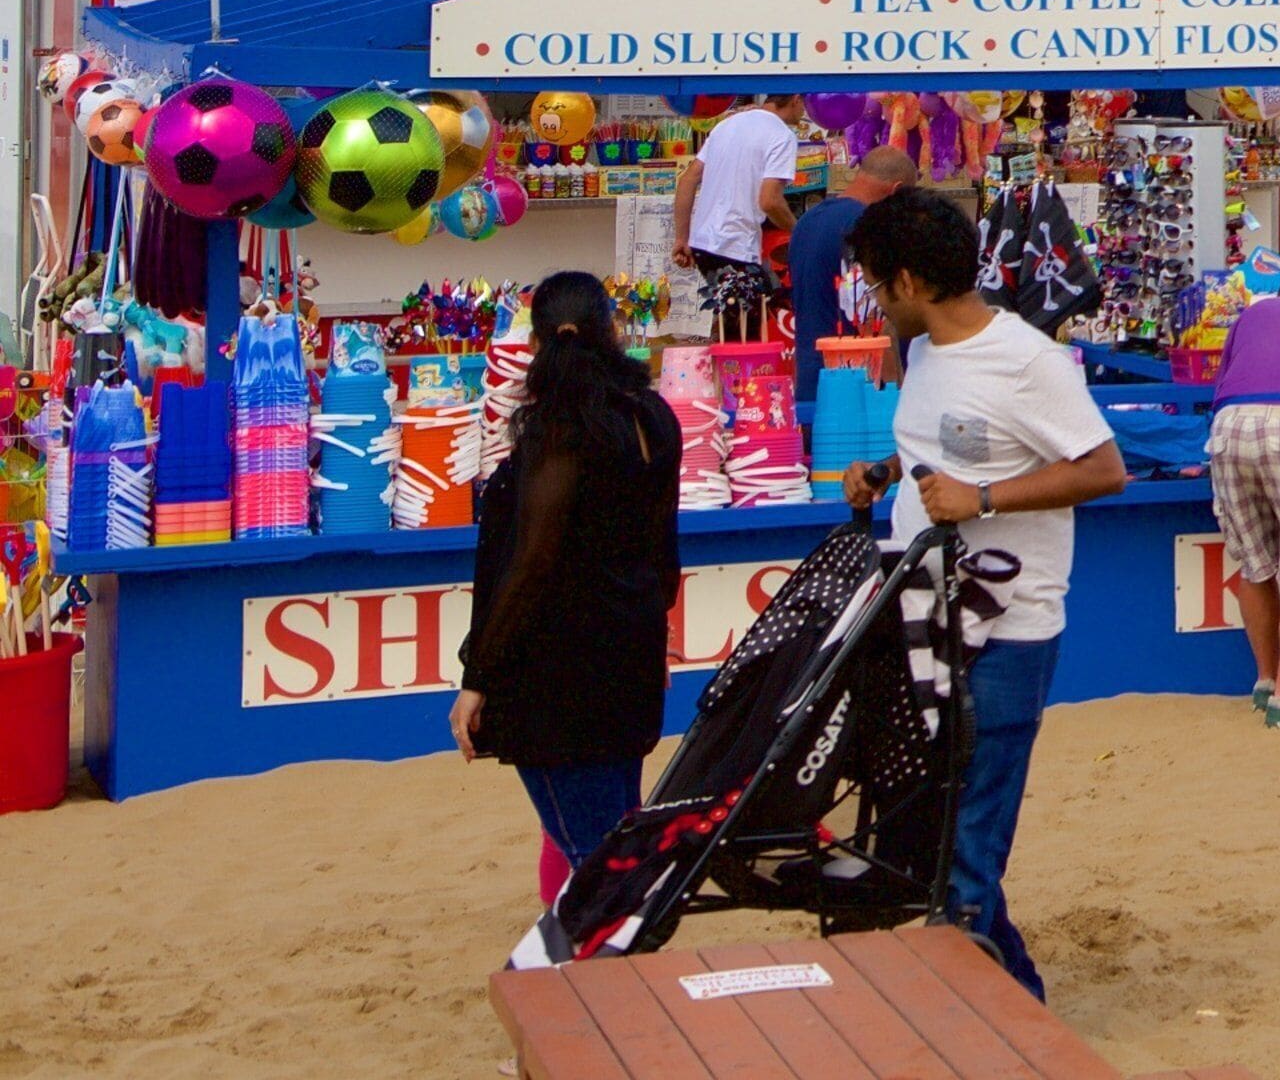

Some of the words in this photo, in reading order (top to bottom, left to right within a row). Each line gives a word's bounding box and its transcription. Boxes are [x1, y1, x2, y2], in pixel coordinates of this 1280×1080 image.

[504, 32, 638, 66] COLD
[653, 31, 800, 65] SLUSH
[843, 28, 971, 62] ROCK
[1009, 26, 1160, 59] CANDY
